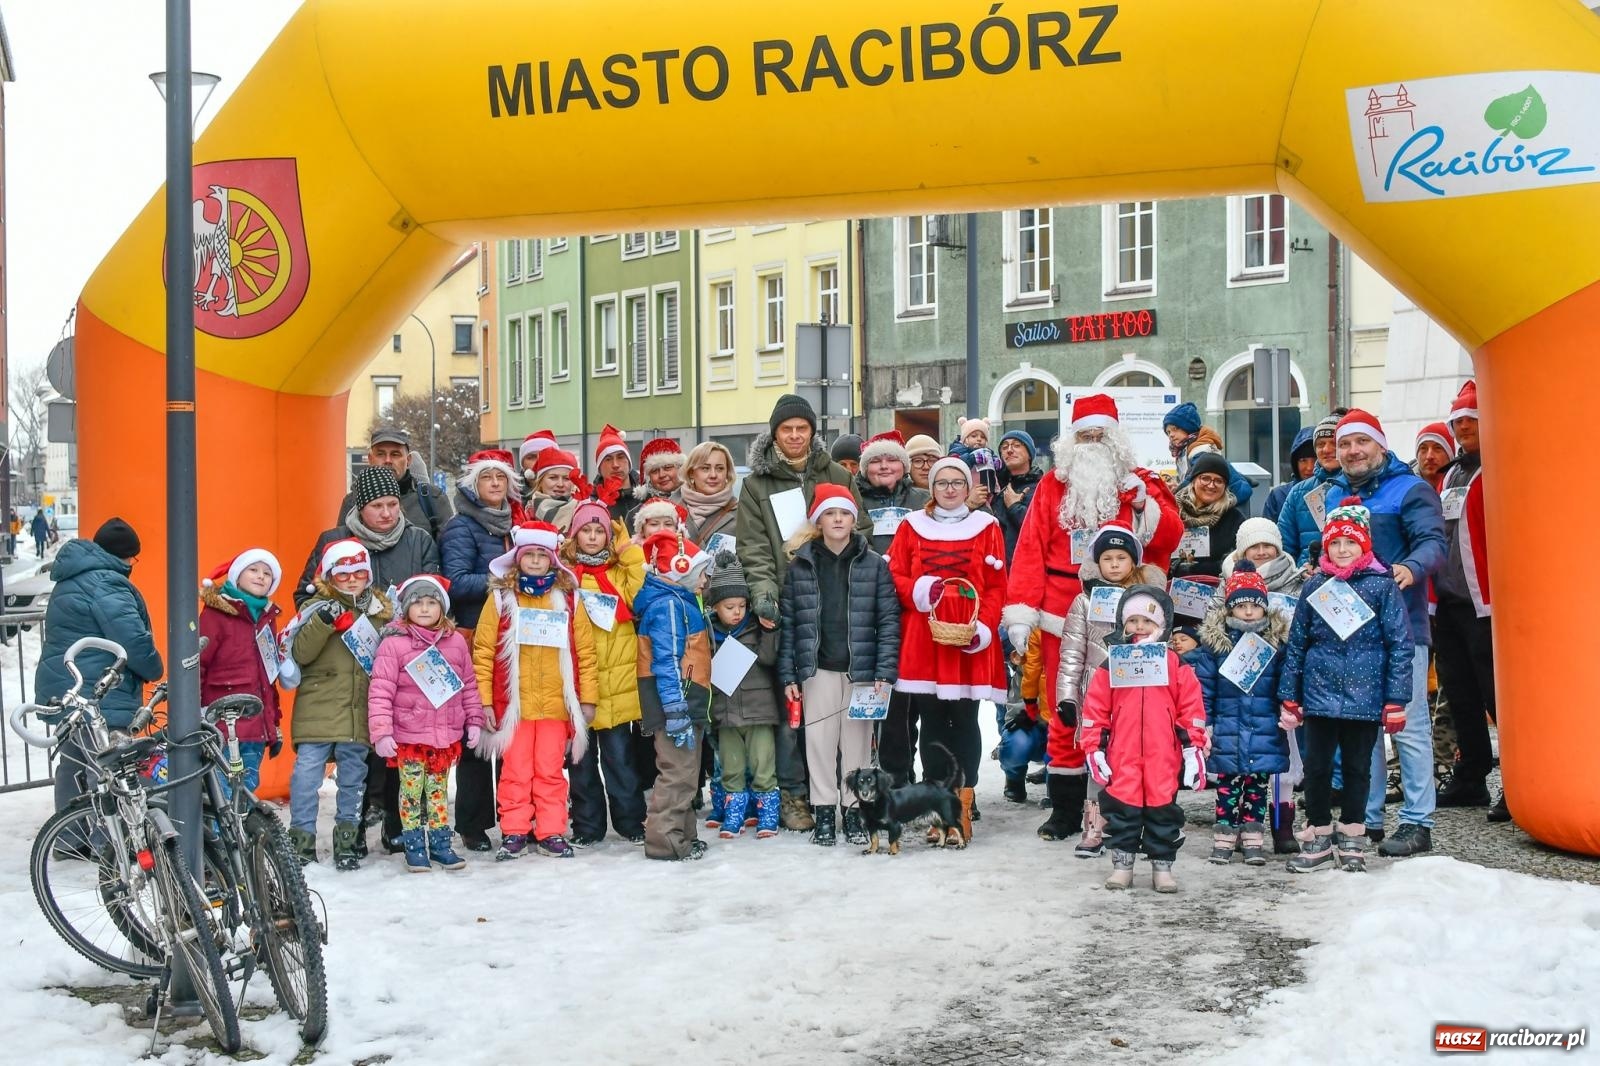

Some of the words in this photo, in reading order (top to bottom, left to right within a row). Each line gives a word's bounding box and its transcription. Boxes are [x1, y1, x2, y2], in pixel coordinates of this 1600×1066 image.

[489, 46, 728, 117] MIASTO
[754, 3, 1121, 95] RACIBÓRZ
[1510, 114, 1522, 127] ISO
[1385, 125, 1596, 195] Racibórz
[1014, 321, 1060, 348] Sailor
[1065, 309, 1153, 342] TATTOO
[1134, 667, 1144, 675] 54
